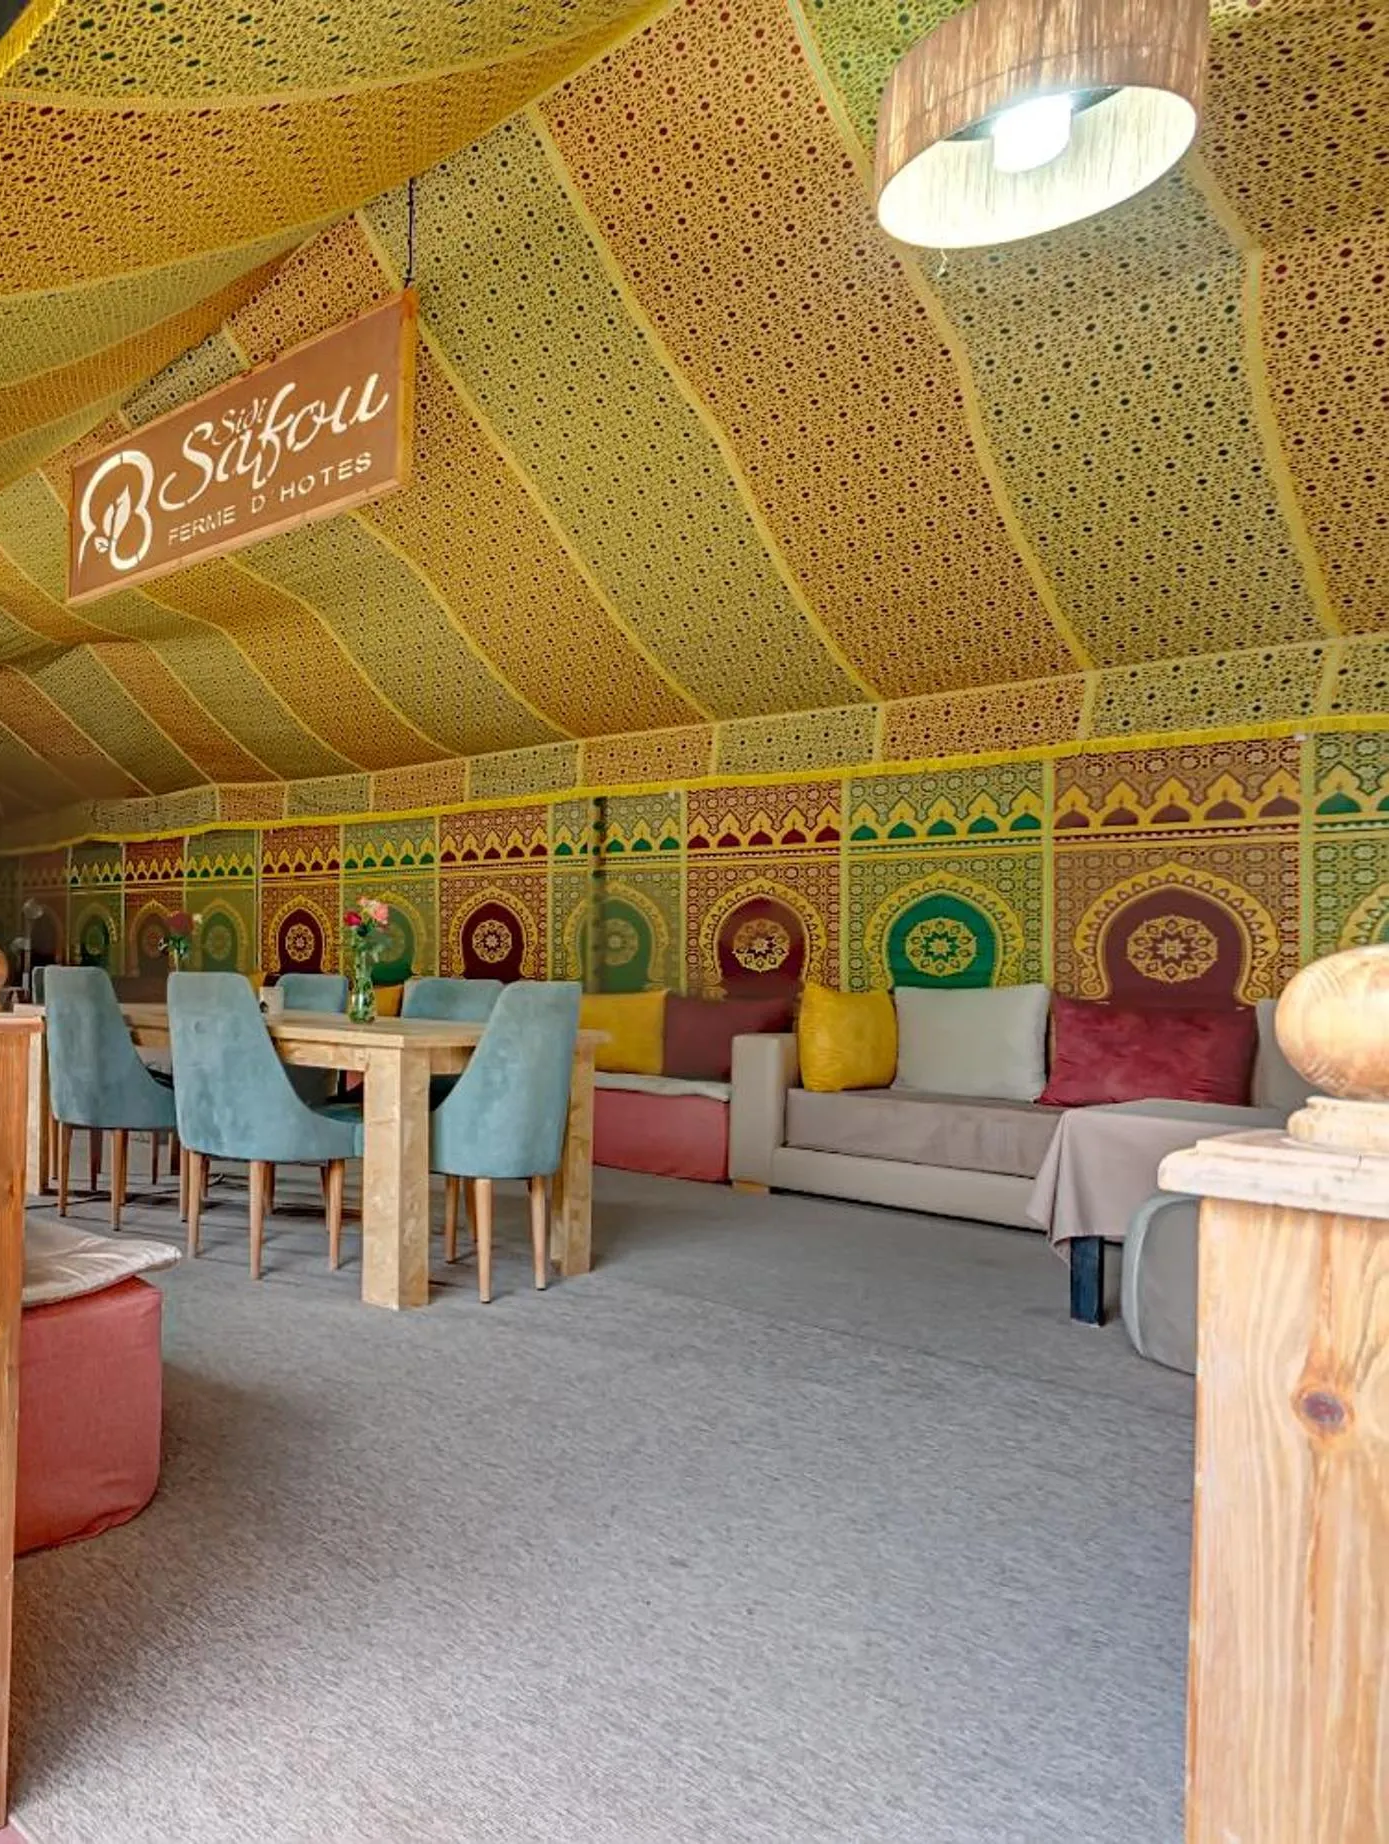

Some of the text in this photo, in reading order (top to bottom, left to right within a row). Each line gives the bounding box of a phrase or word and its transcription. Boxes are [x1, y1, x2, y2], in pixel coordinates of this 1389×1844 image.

[158, 373, 390, 511] Safou
[212, 398, 268, 445] Sidi
[168, 505, 237, 546] FERME
